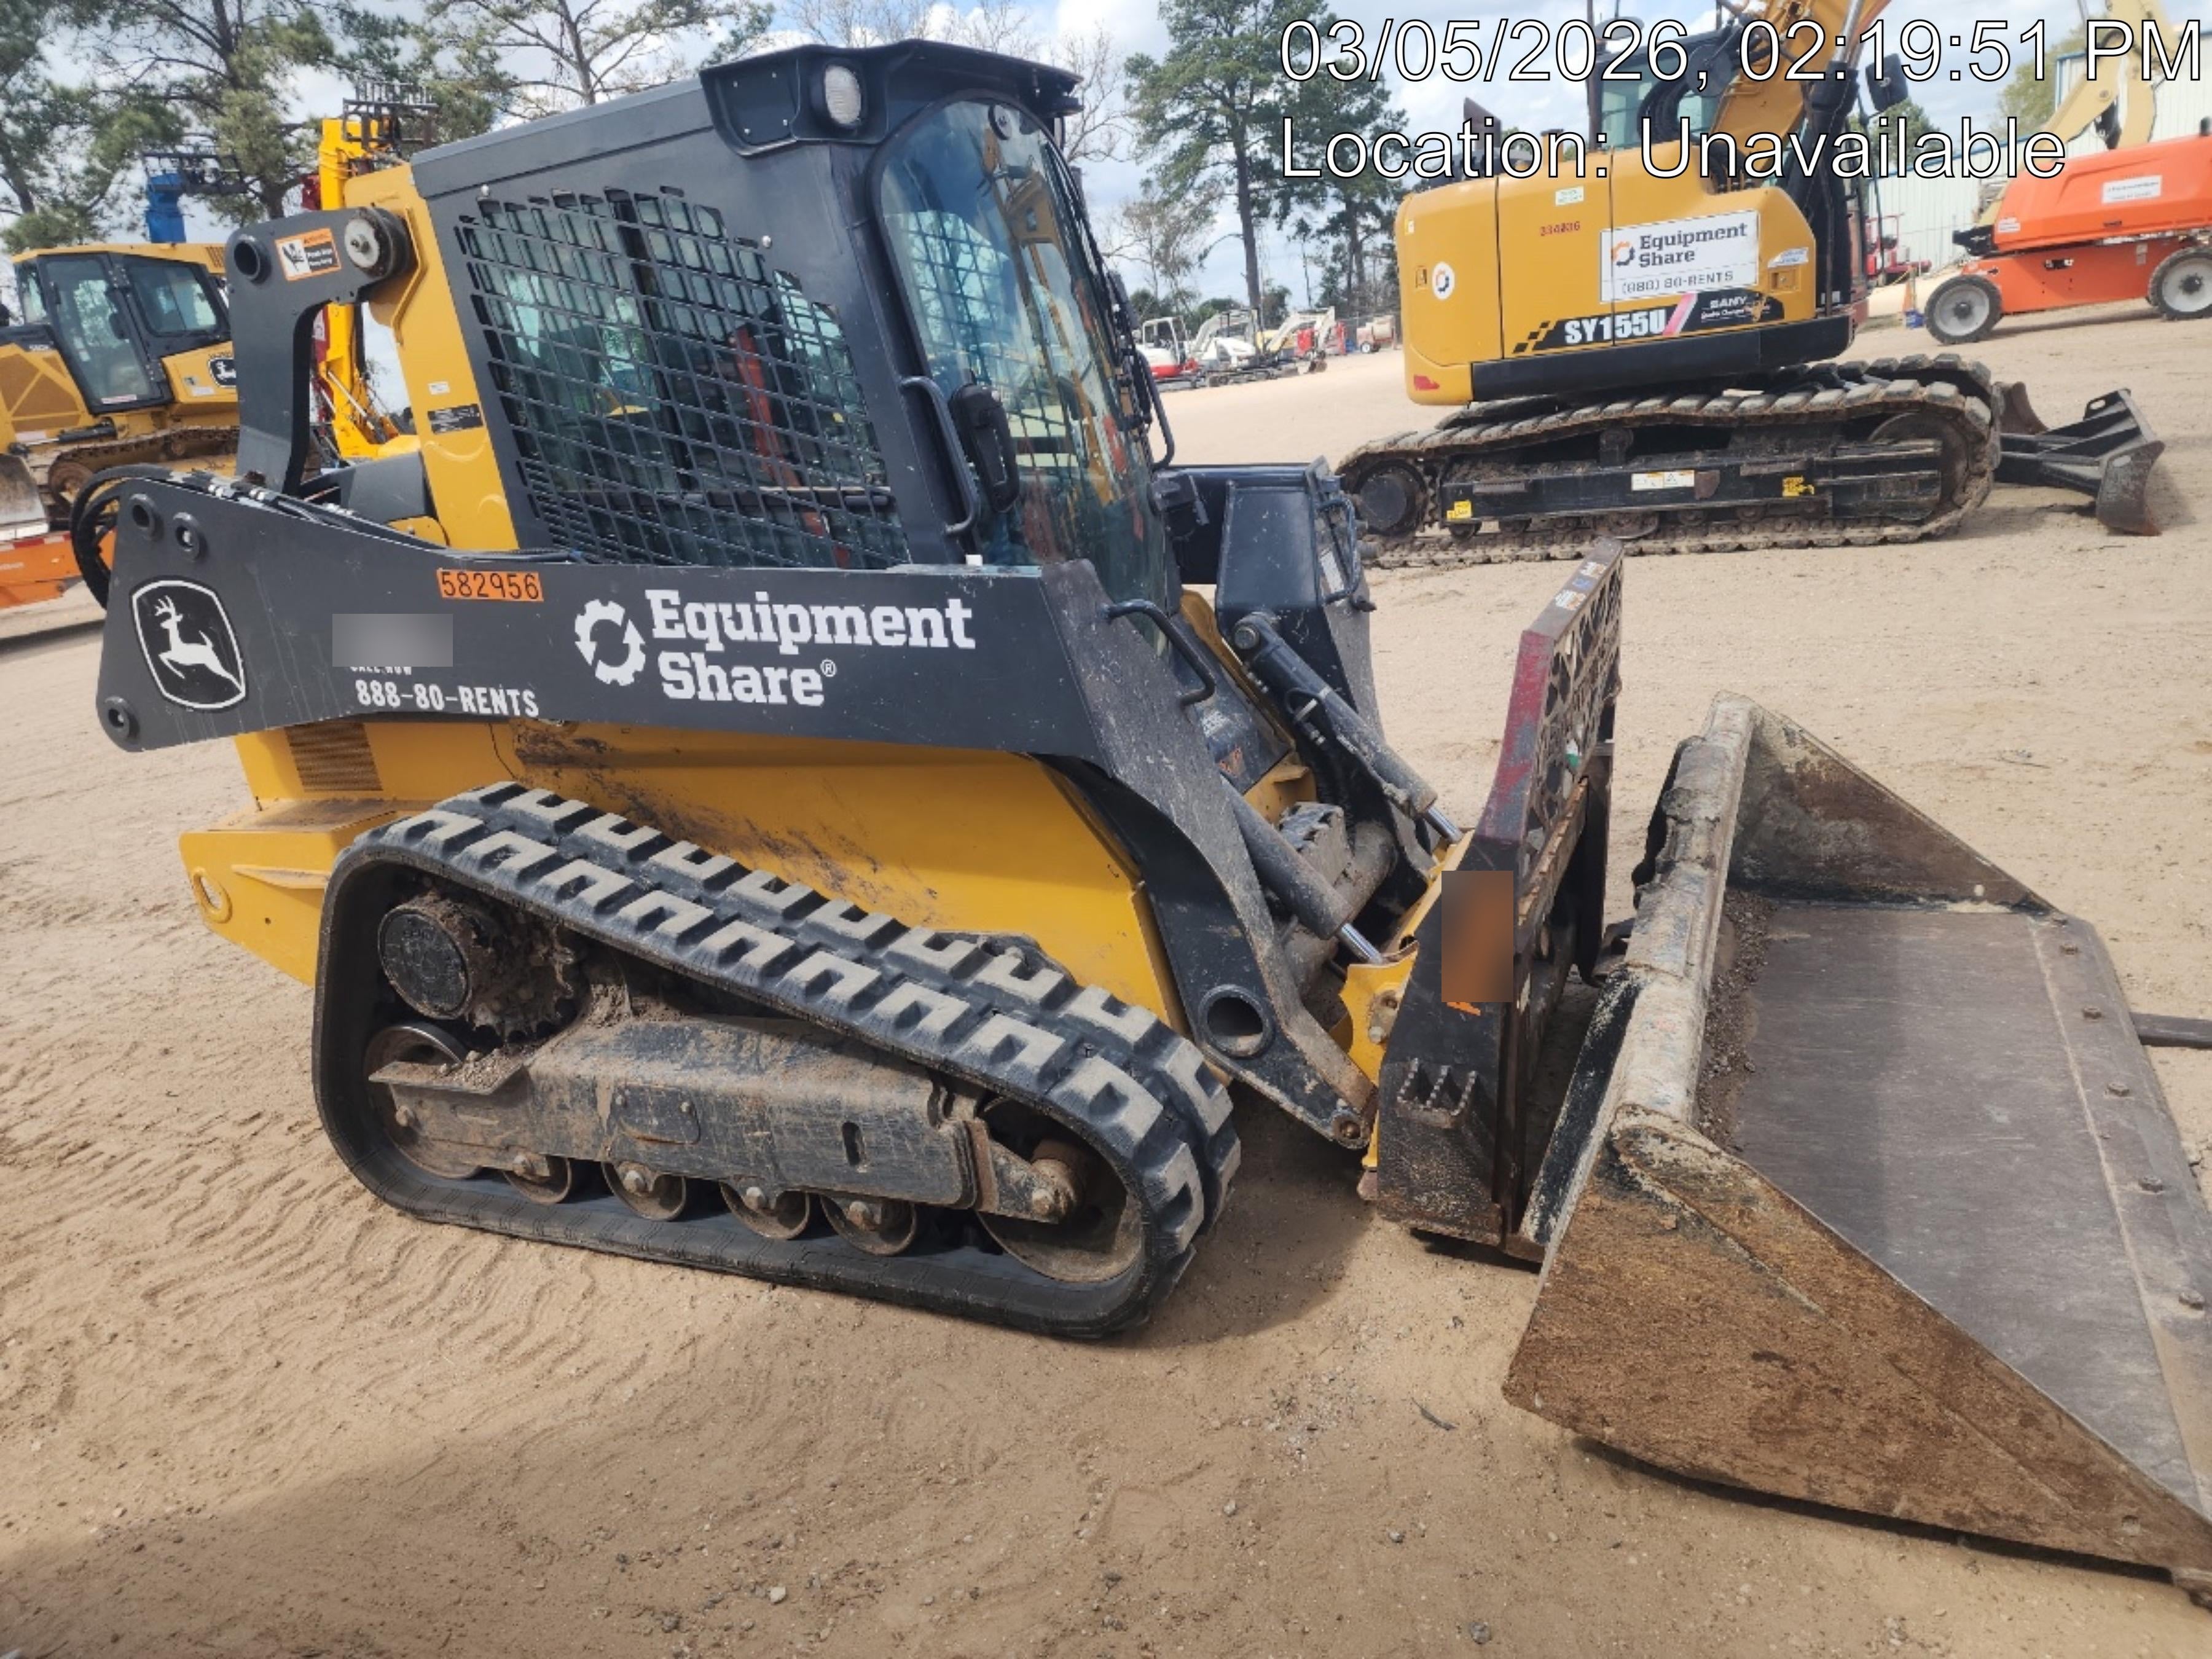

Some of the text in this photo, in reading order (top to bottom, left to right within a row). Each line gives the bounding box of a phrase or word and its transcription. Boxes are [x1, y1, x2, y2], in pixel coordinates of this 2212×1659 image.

[1640, 222, 1748, 251] Equipment
[1639, 249, 1695, 268] Share
[1564, 308, 1666, 344] SY155U
[441, 571, 539, 599] 582956
[645, 589, 976, 655] Equipment
[355, 679, 539, 718] 888-80-RENTS
